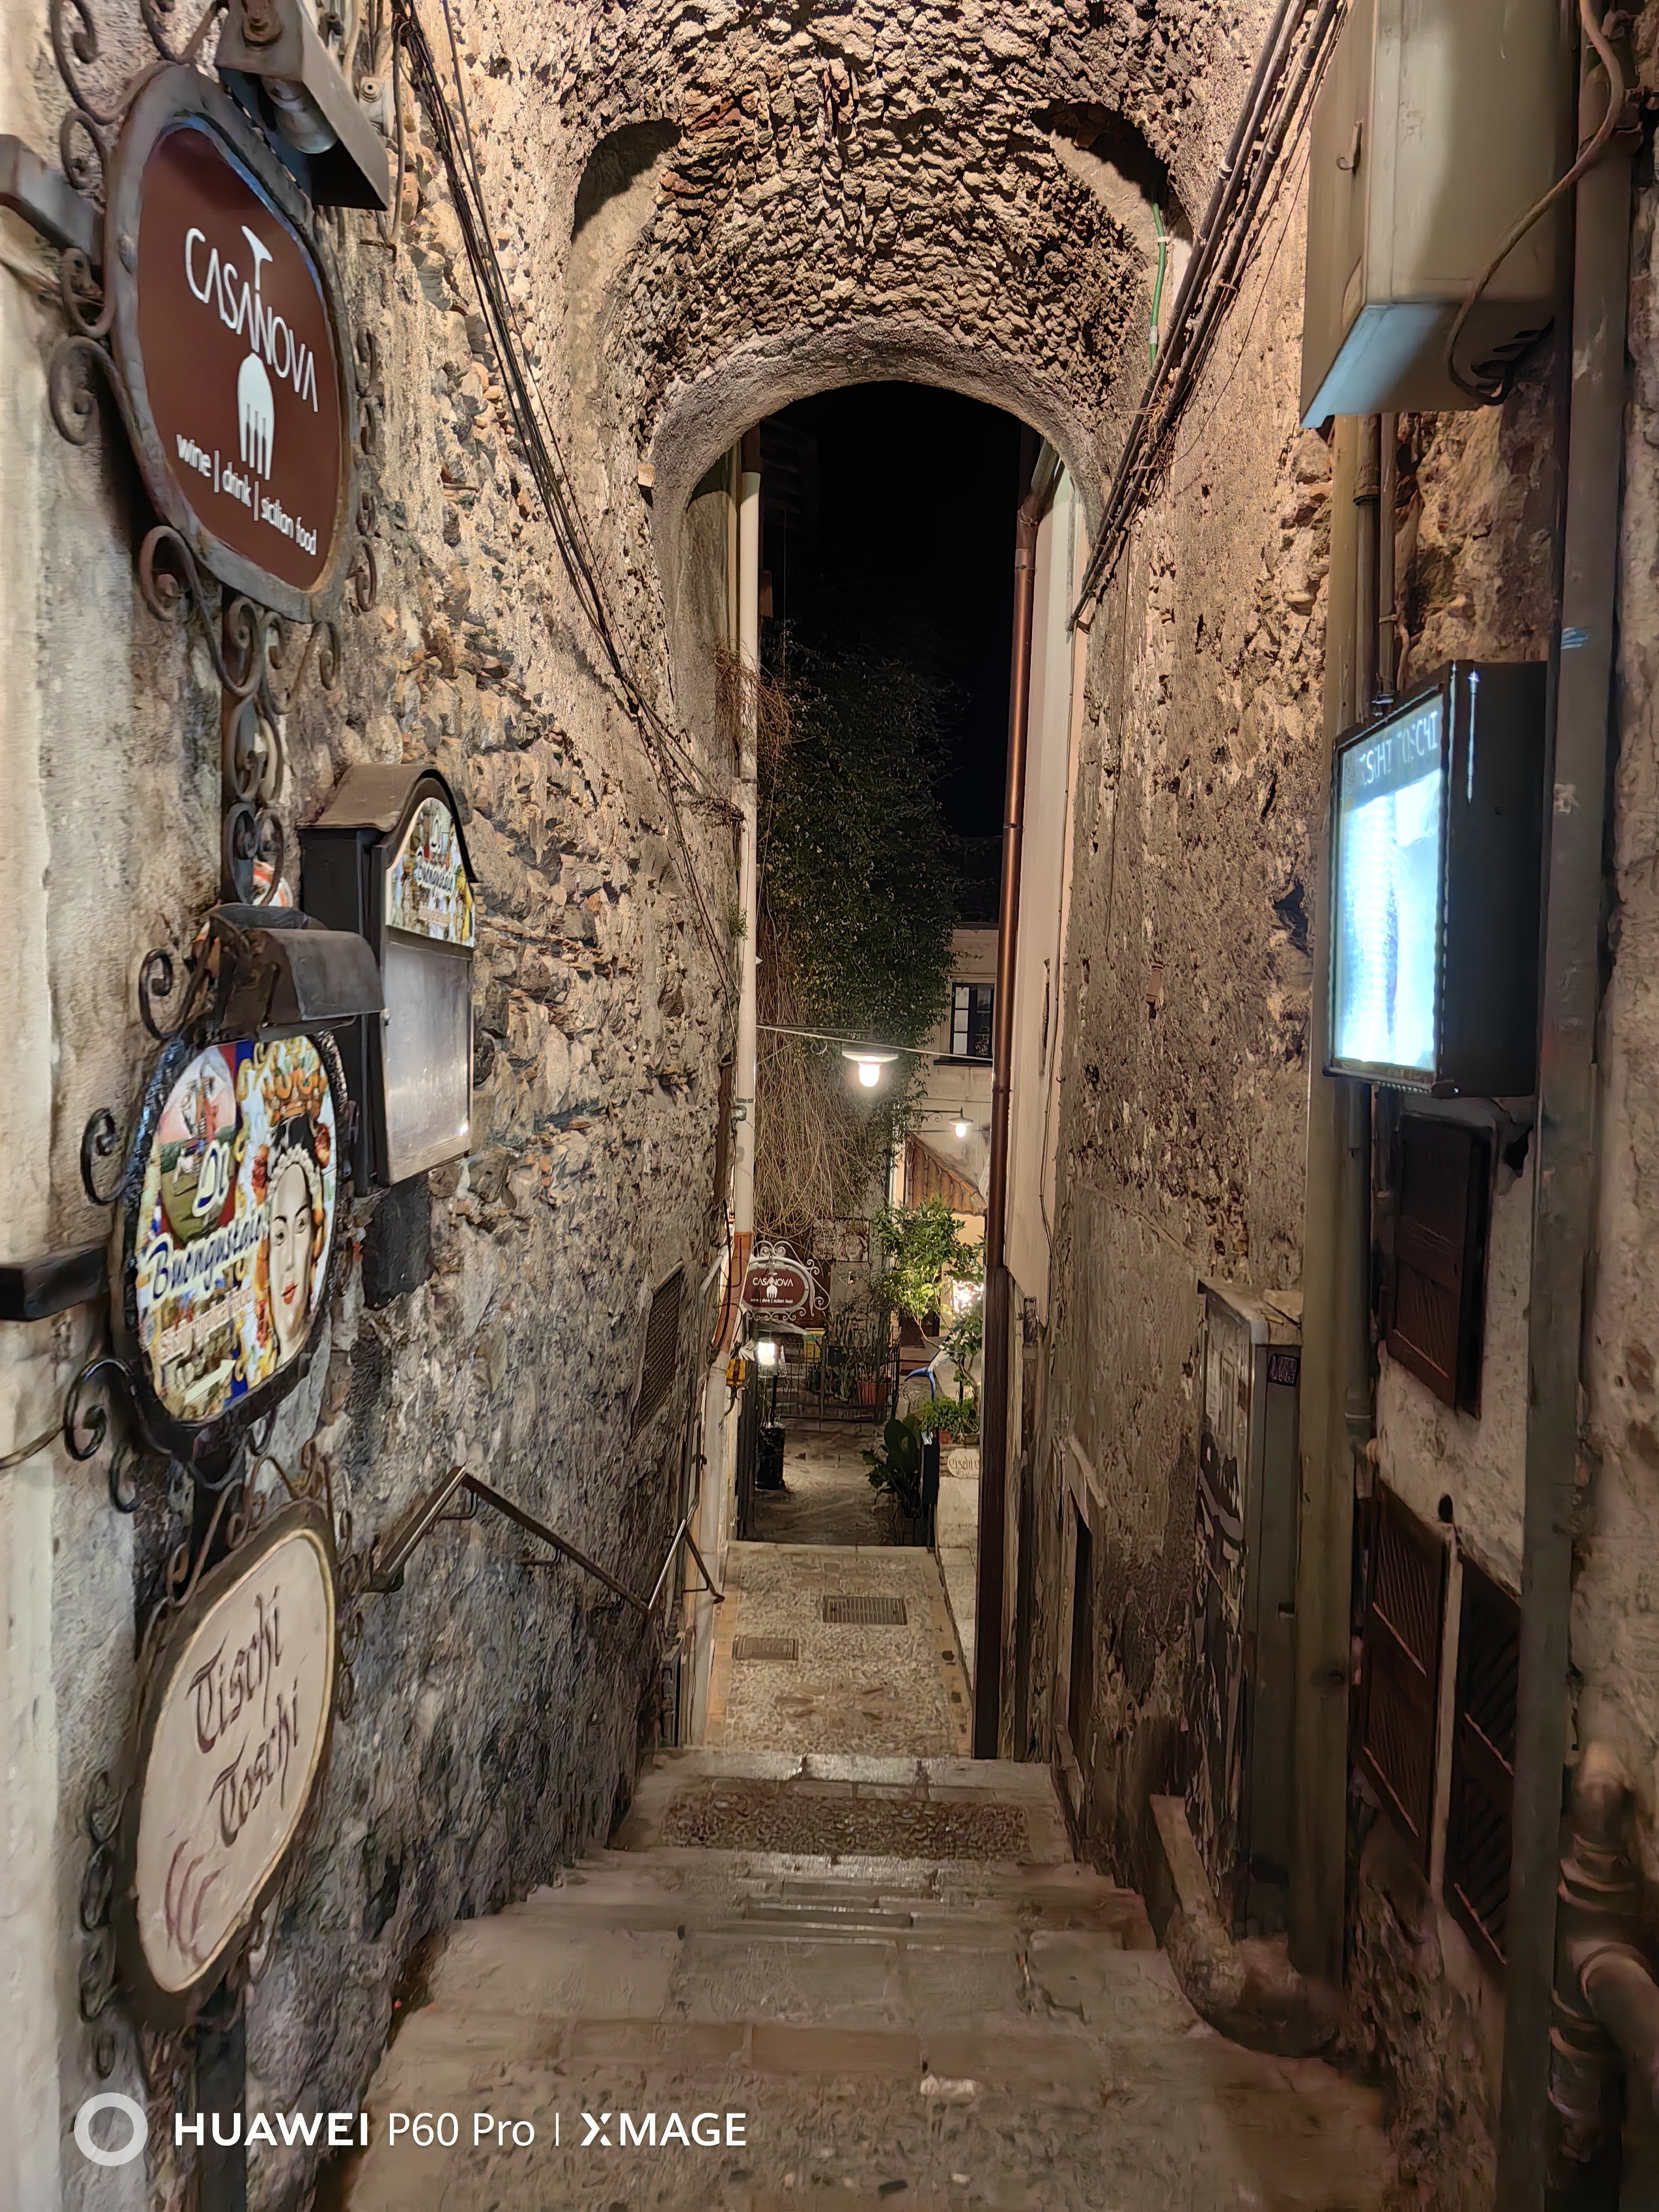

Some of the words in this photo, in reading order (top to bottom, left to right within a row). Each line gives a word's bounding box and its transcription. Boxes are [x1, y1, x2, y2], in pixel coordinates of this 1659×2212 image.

[185, 227, 318, 413] CASANOVA
[176, 434, 212, 477] wine
[222, 461, 252, 508] drink
[295, 516, 317, 556] food
[753, 1276, 794, 1287] CASANOVA
